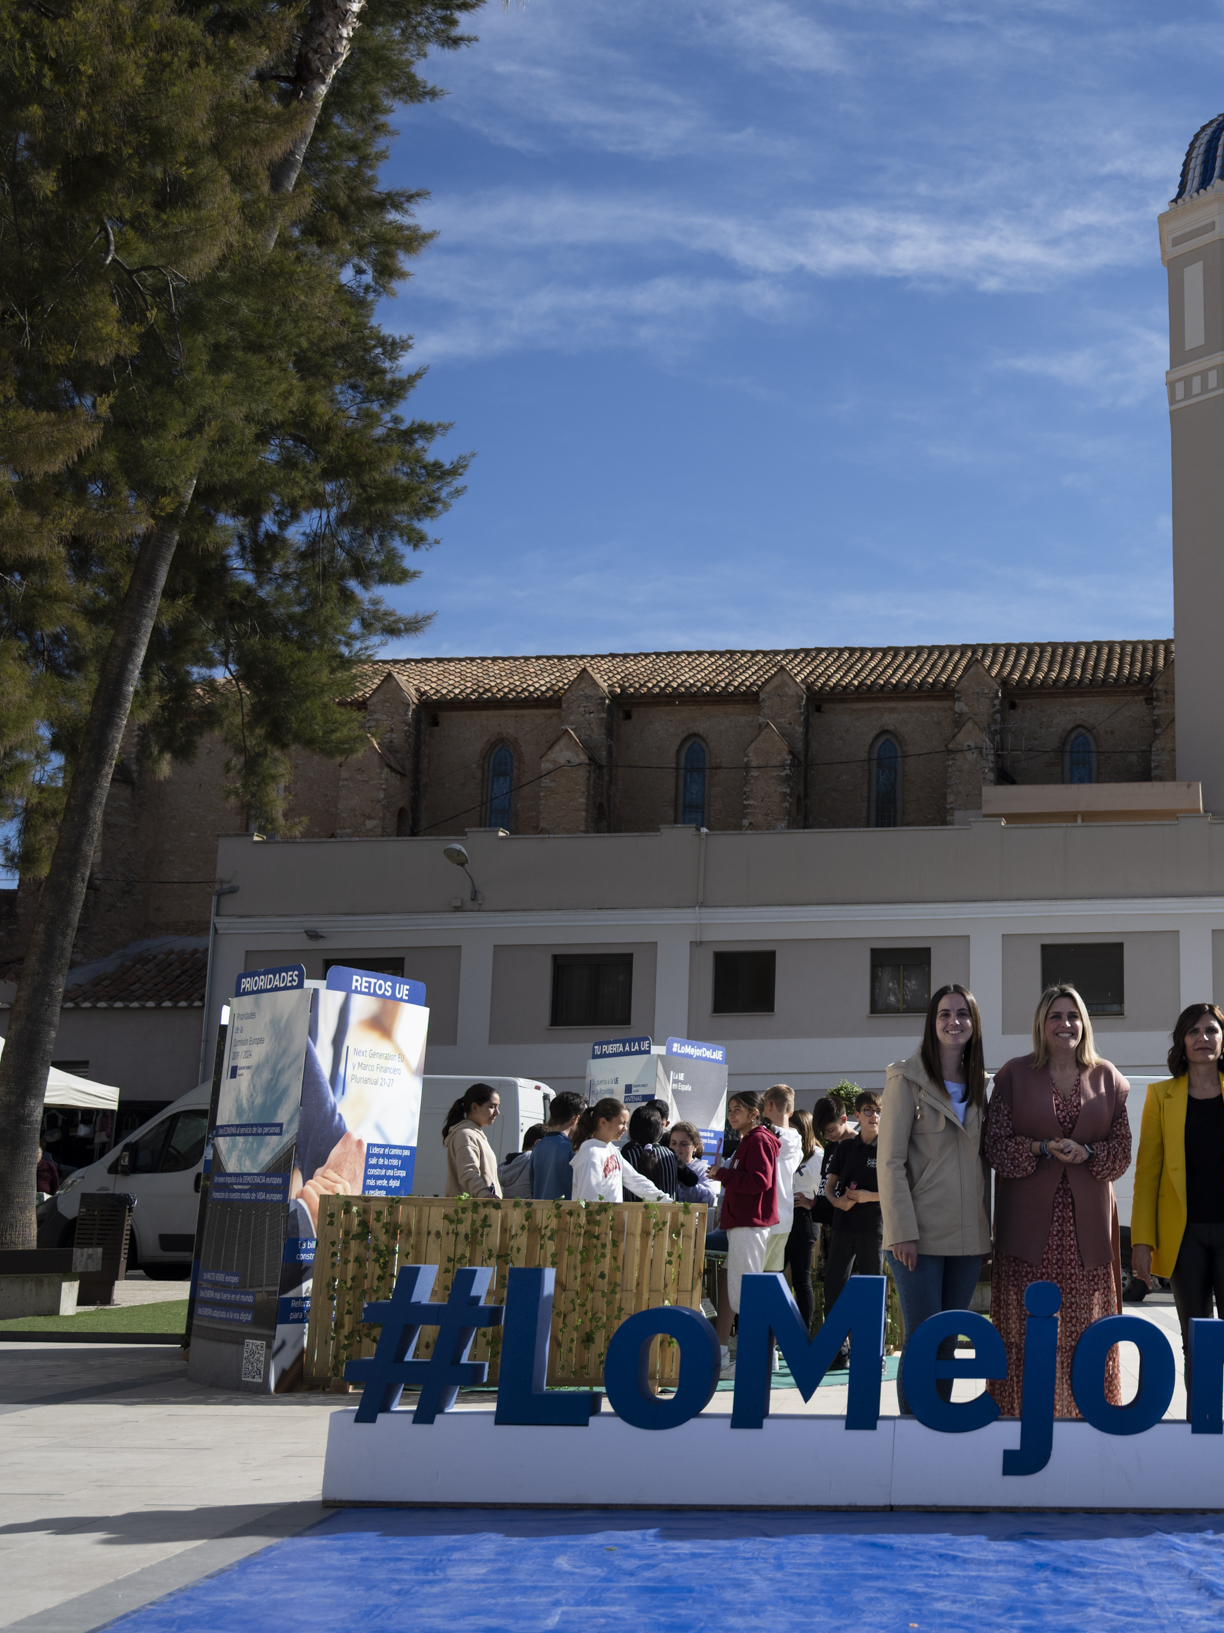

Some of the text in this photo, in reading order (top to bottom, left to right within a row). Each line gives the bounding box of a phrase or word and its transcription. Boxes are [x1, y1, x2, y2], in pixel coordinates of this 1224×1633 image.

[240, 971, 299, 993] PRIORIDADES
[352, 975, 410, 999] RETOS UE
[237, 1012, 257, 1020] Prioridades
[234, 1037, 265, 1047] Comisión Europea
[594, 1040, 650, 1055] TU PUERTA A LA UE
[672, 1043, 723, 1060] #LoMejorDeLaUE
[353, 1048, 405, 1062] Next Generation EU
[352, 1062, 401, 1075] y Marco Financiero
[351, 1074, 394, 1087] Plurianual 21-27
[252, 1126, 257, 1134] de
[263, 1126, 281, 1135] personas
[369, 1146, 384, 1154] Liderar
[402, 1149, 411, 1157] para
[368, 1156, 378, 1164] salir
[378, 1157, 384, 1165] de
[384, 1157, 388, 1165] la
[389, 1158, 398, 1166] crisis
[394, 1168, 406, 1178] Europa
[243, 1176, 265, 1184] DEMOCRACIA
[266, 1177, 282, 1185] europea
[366, 1178, 400, 1188] más verde, digital
[251, 1192, 256, 1200] de
[256, 1192, 265, 1200] VIDA
[266, 1193, 283, 1201] europeo
[225, 1275, 239, 1284] europeo
[221, 1291, 231, 1300] fuerte
[236, 1293, 240, 1301] el
[240, 1294, 254, 1303] mundo
[240, 1312, 252, 1322] digital
[289, 1312, 303, 1321] para
